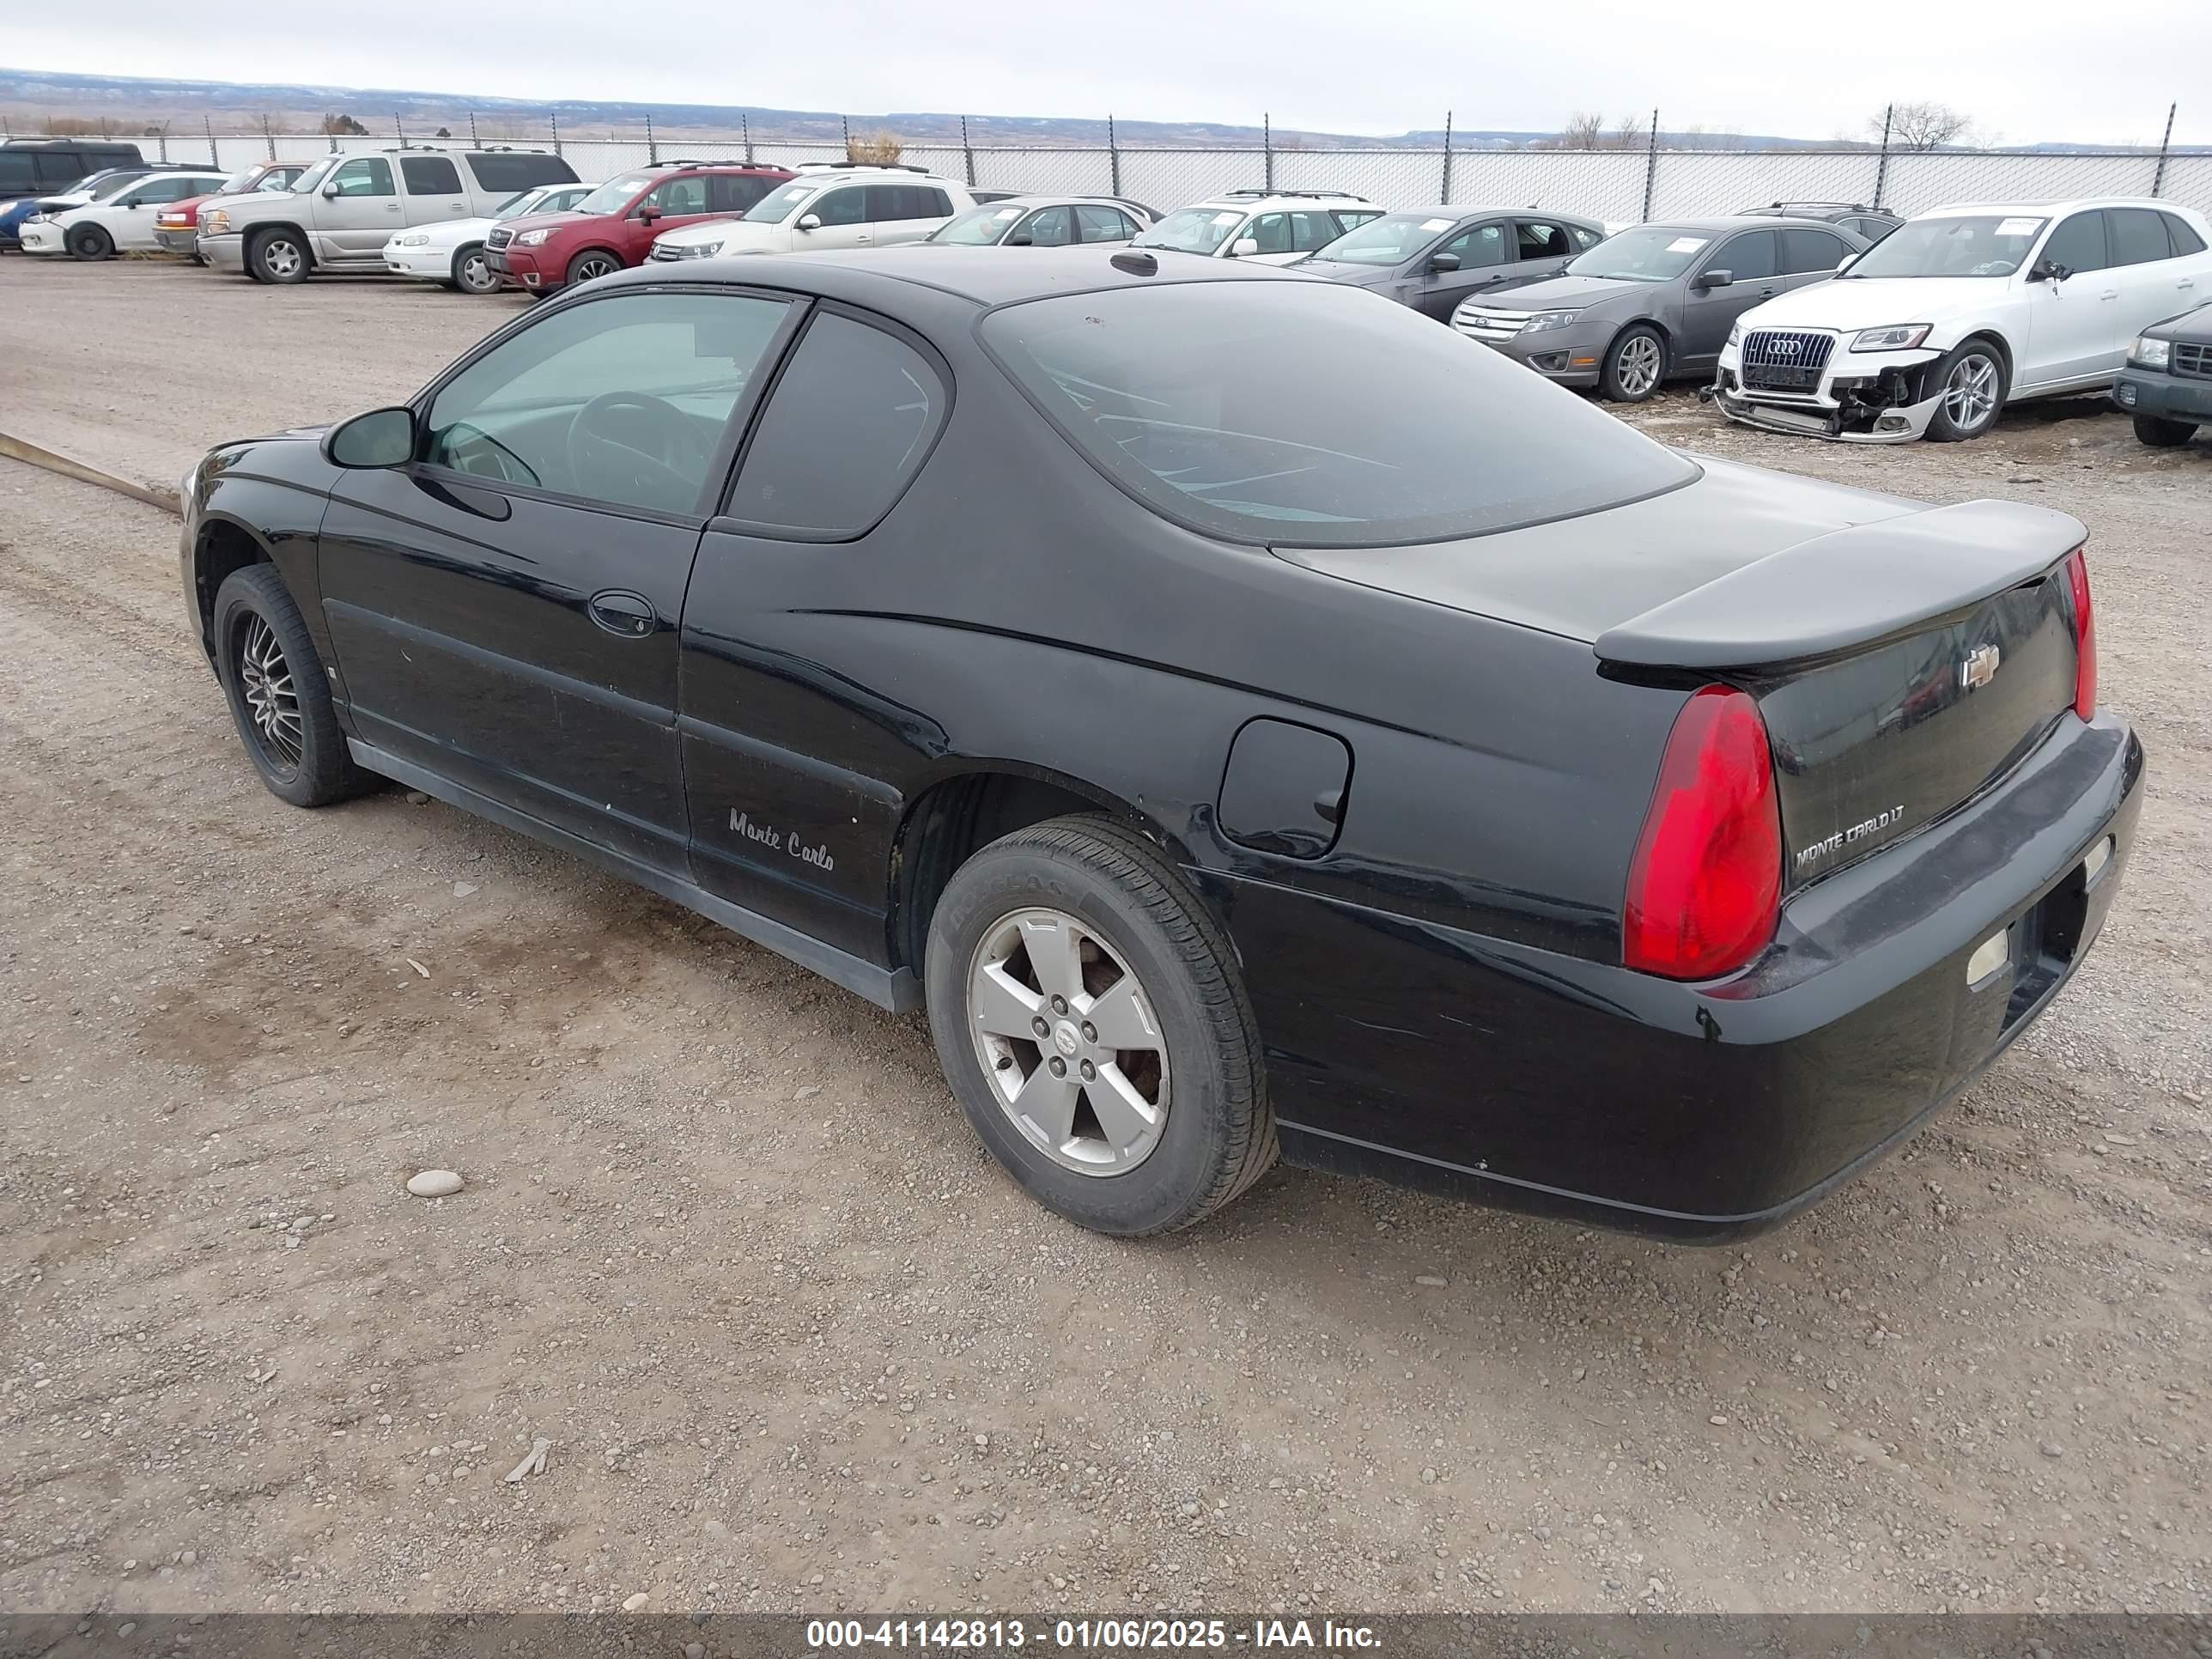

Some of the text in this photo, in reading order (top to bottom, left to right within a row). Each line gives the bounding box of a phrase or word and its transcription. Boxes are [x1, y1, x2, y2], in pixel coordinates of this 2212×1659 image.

[730, 807, 834, 871] Monte Carlo
[1796, 805, 1905, 867] MONTE CARLO LT
